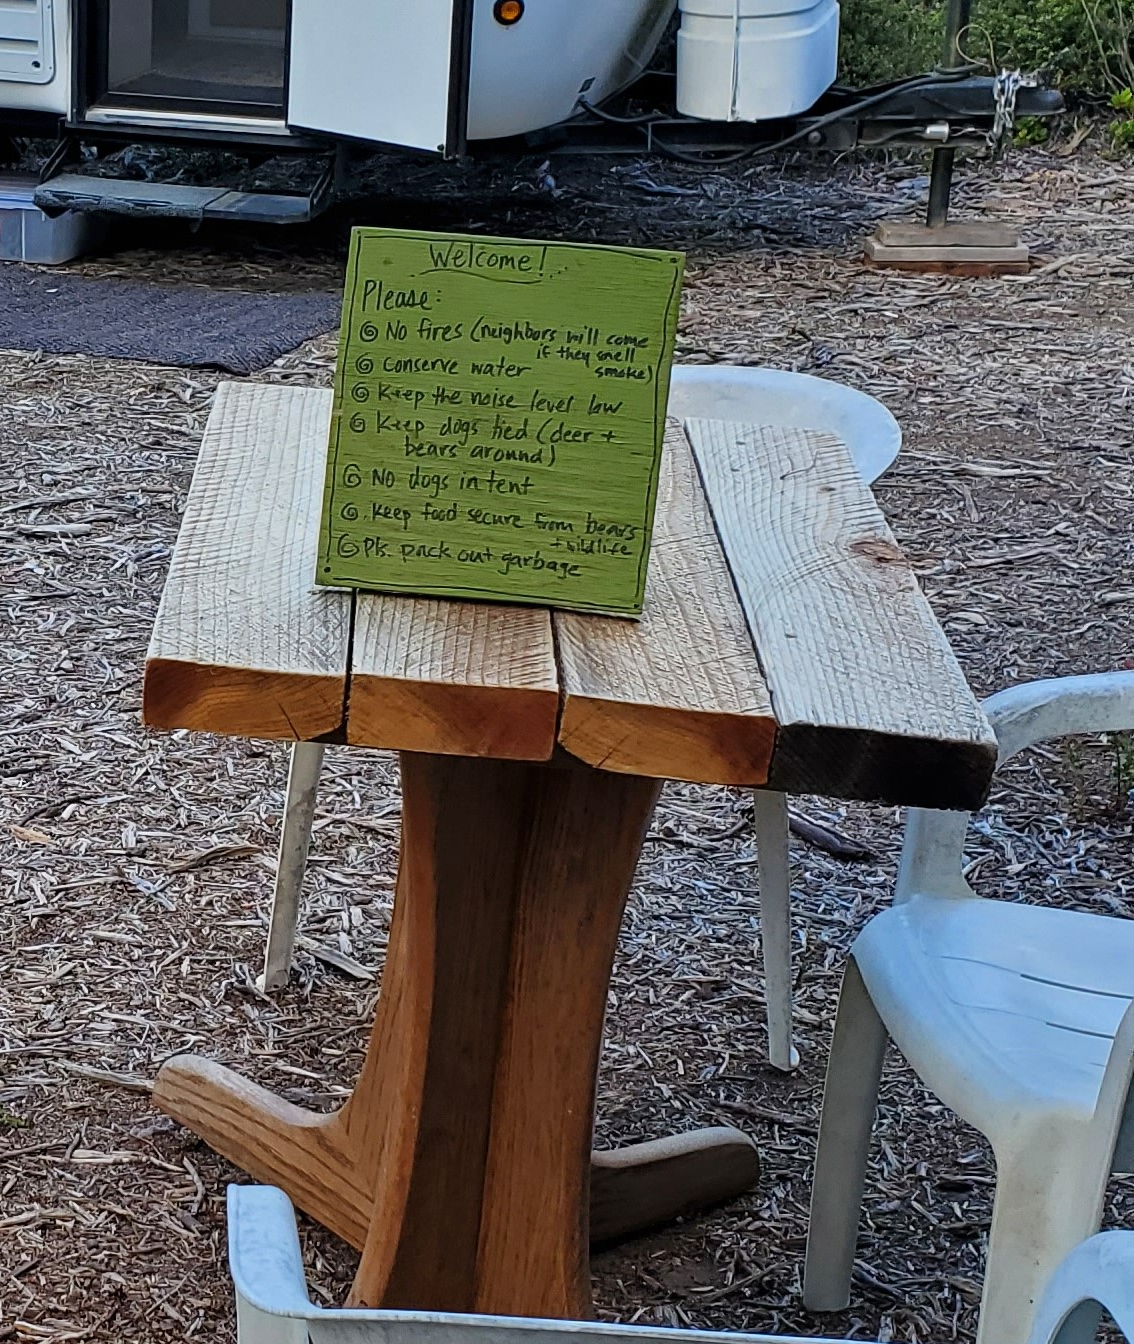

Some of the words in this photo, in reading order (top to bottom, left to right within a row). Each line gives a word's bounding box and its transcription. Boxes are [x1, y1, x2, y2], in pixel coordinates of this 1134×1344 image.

[429, 242, 547, 277] Welcome!
[362, 280, 442, 312] Please:
[386, 320, 408, 341] No
[417, 317, 463, 342] fires
[470, 315, 557, 345] (neighbors
[566, 325, 599, 345] will
[606, 334, 649, 348] come
[471, 356, 532, 377] water
[537, 343, 551, 359] if
[556, 345, 590, 367] they
[594, 365, 653, 385] smoke)
[378, 381, 426, 410] Keep
[432, 385, 463, 405] the
[470, 387, 522, 409] noise
[530, 389, 574, 414] level
[588, 393, 624, 416] low
[376, 410, 425, 439] Keep
[439, 417, 479, 446] dogs
[491, 414, 528, 440] tied
[536, 417, 594, 444] (deer
[404, 435, 458, 457] bears
[470, 444, 556, 467] around)
[409, 466, 449, 499] dogs
[459, 472, 480, 490] in
[486, 469, 535, 496] tent
[421, 503, 458, 522] food
[468, 508, 525, 529] secure
[534, 513, 574, 533] from
[585, 512, 638, 540] bears
[401, 541, 452, 563] pack
[458, 547, 494, 563] out
[497, 550, 583, 579] garbage
[566, 536, 633, 556] wildlife
